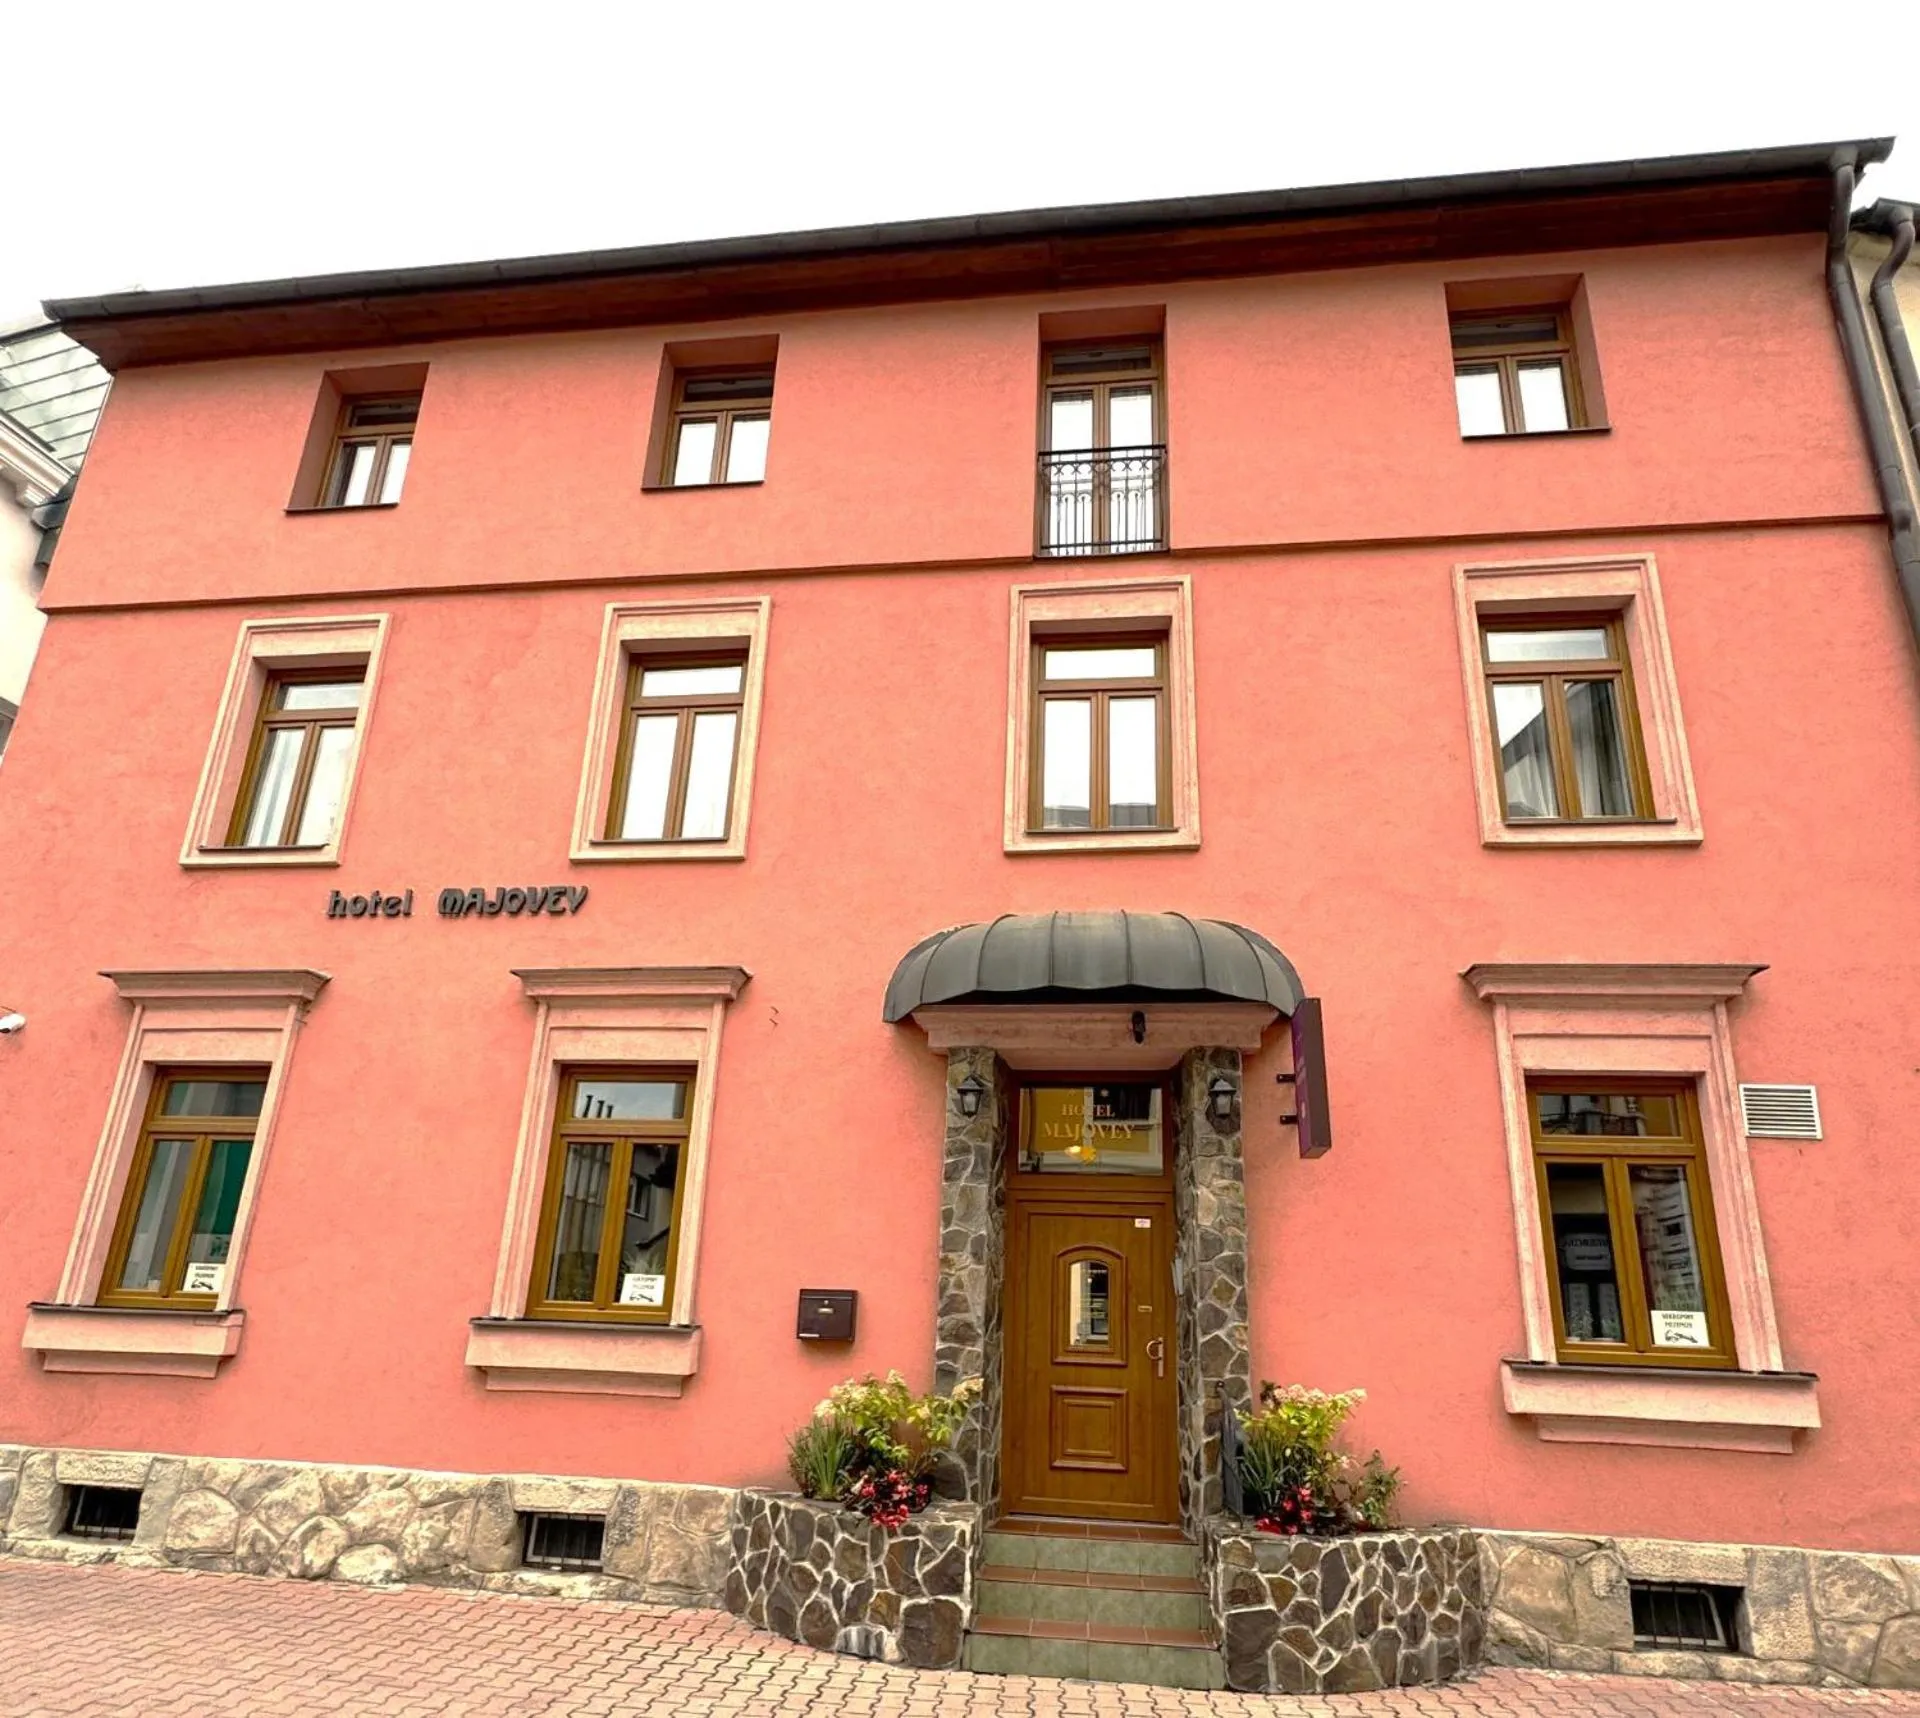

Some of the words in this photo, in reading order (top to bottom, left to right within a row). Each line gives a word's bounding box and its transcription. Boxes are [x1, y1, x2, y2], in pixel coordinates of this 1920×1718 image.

[328, 889, 413, 917] hotel
[1061, 1104, 1115, 1117] HOEL
[1041, 1122, 1135, 1141] MAJOVEY
